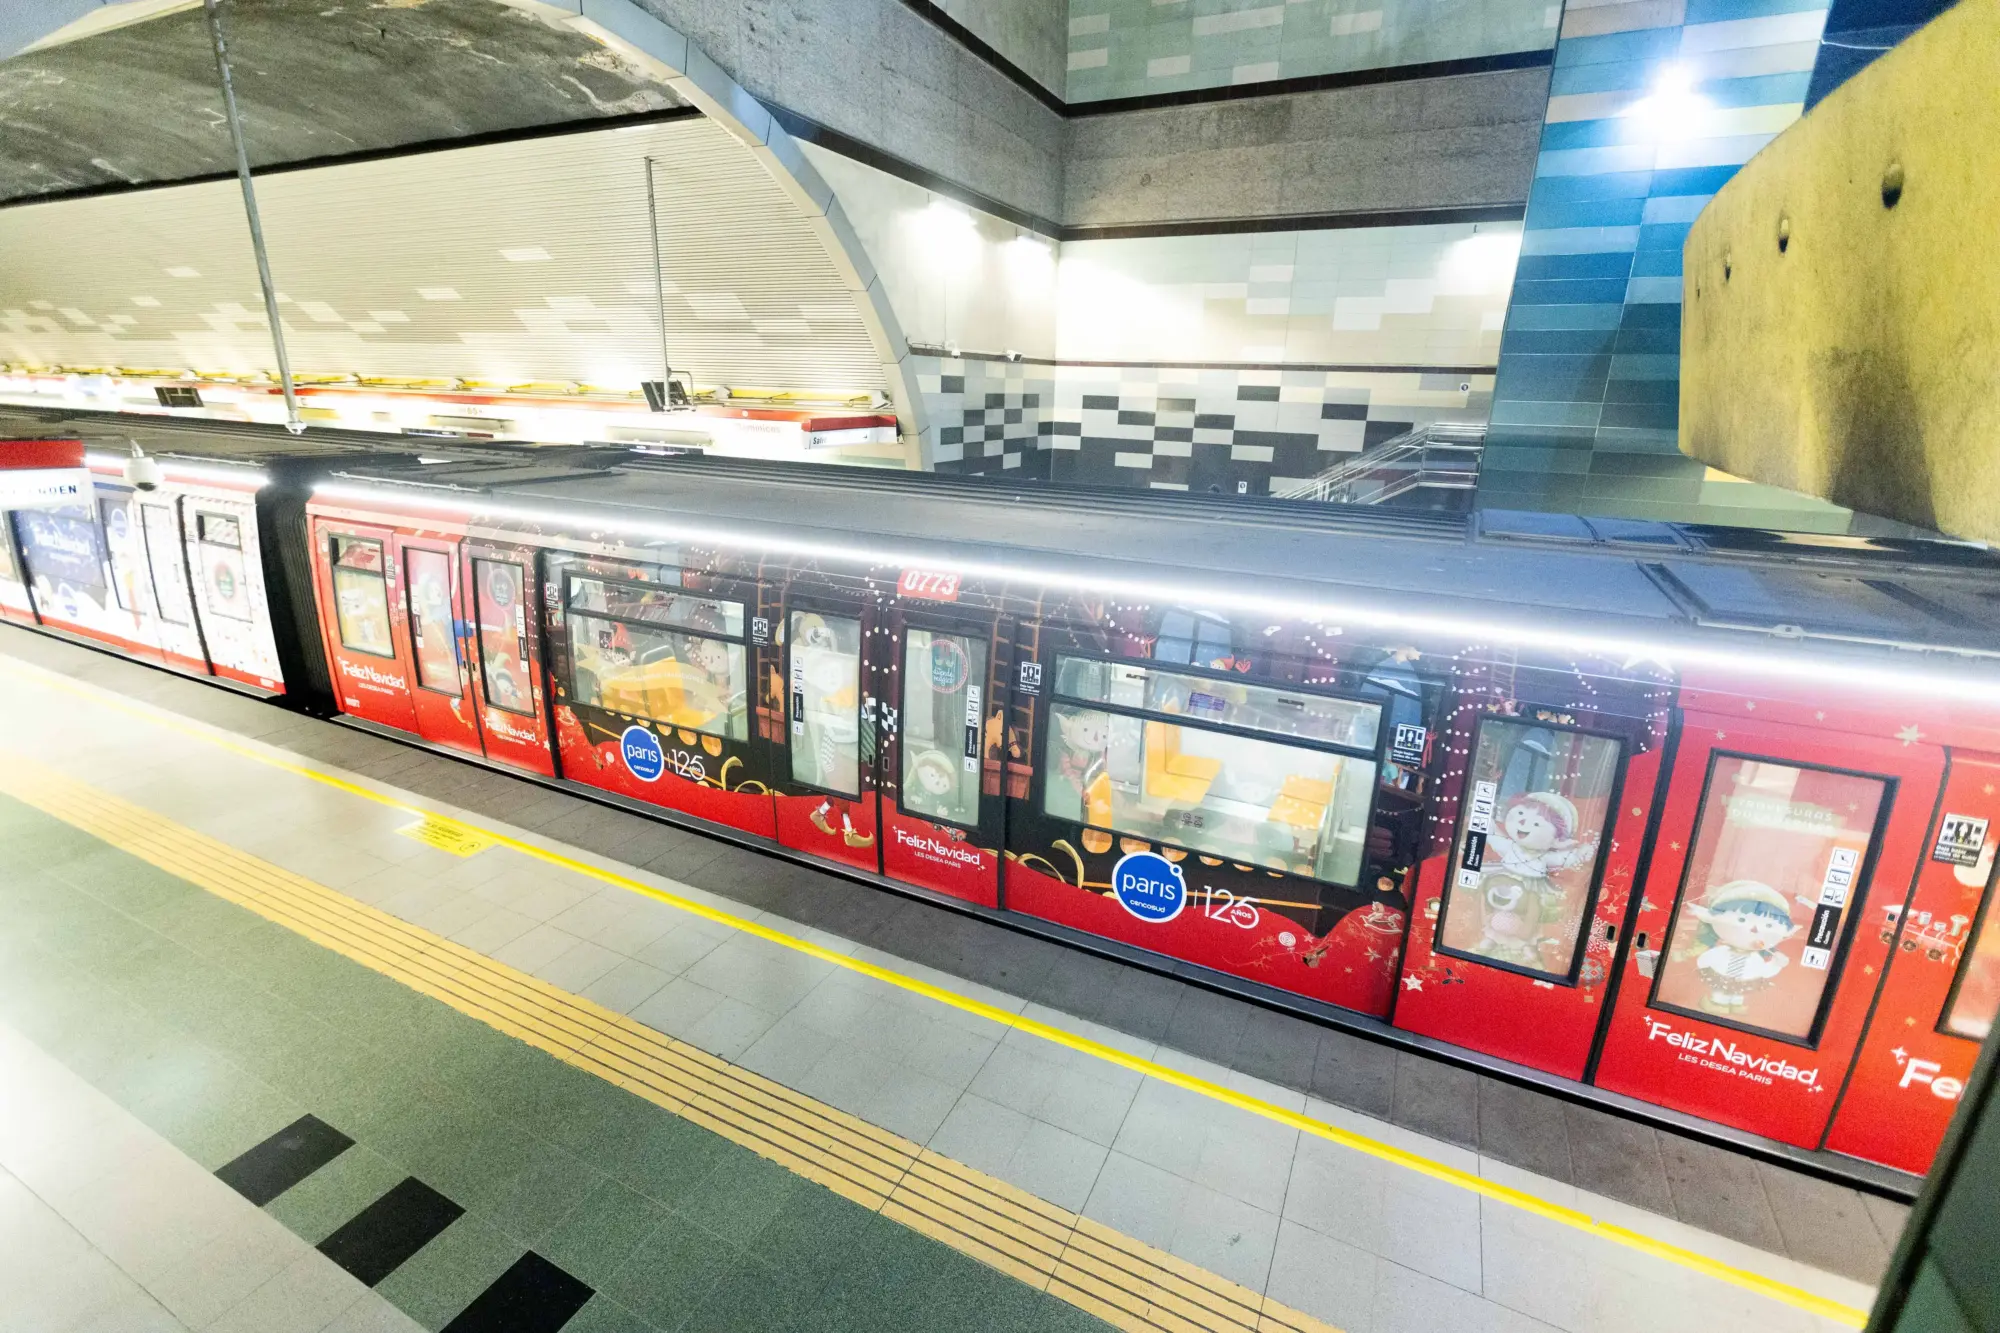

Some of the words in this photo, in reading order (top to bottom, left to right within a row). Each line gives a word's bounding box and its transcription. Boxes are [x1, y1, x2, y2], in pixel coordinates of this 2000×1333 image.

[904, 570, 956, 595] 0773
[364, 665, 406, 690] Navidad
[626, 744, 659, 763] paris
[671, 748, 706, 781] 125
[897, 828, 928, 850] Feliz
[928, 837, 980, 865] Navidad
[1467, 835, 1478, 866] Precaución
[925, 854, 944, 864] DESEA
[944, 860, 962, 869] PARIS
[1122, 873, 1176, 901] paris
[1130, 899, 1166, 913] cencosud
[1203, 885, 1260, 929] 125
[1230, 909, 1252, 919] AÑOS
[1814, 909, 1830, 943] Precaución
[1648, 1021, 1710, 1055] Feliz
[1709, 1037, 1818, 1085] Navidad
[1678, 1053, 1698, 1063] LES
[1699, 1058, 1736, 1076] DESEA
[1738, 1069, 1773, 1085] PARIS
